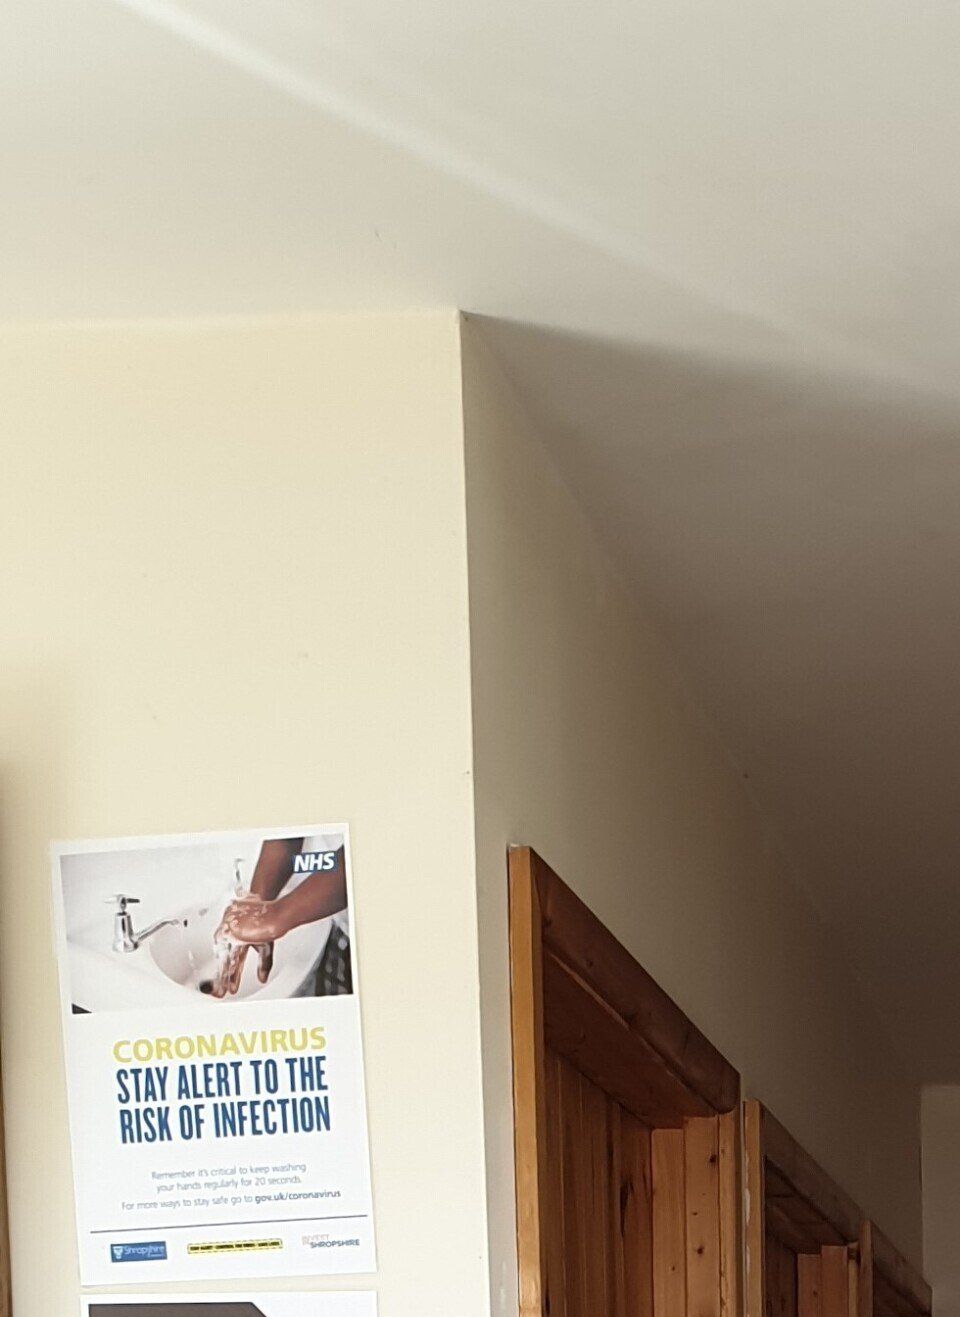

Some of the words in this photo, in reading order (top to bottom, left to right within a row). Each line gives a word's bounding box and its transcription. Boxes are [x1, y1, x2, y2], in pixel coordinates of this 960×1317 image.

[294, 853, 334, 872] NHS
[112, 1027, 327, 1063] CORONAVIRUS
[116, 1065, 168, 1104] STAY
[177, 1062, 243, 1101] ALERT
[250, 1059, 279, 1096] TO
[287, 1055, 329, 1094] THE
[119, 1107, 172, 1144] RISK
[180, 1104, 205, 1141] OF
[213, 1095, 332, 1139] INFECTION
[151, 1170, 195, 1180] Remember
[198, 1168, 208, 1177] it's
[210, 1166, 237, 1176] critical
[239, 1166, 248, 1175] to
[250, 1165, 269, 1175] keep
[272, 1163, 307, 1173] washing
[156, 1184, 175, 1194] your
[176, 1181, 202, 1191] hands
[204, 1178, 238, 1189] regularly
[241, 1177, 252, 1187] for
[254, 1177, 266, 1186] 20
[121, 1201, 135, 1211] For
[137, 1202, 158, 1210] more
[160, 1200, 181, 1209] ways
[182, 1198, 192, 1207] to
[193, 1197, 210, 1207] stay
[212, 1195, 229, 1205] safe
[230, 1196, 242, 1206] go
[244, 1194, 253, 1203] to
[254, 1188, 341, 1205] gov.uk/coronavirus
[310, 1238, 361, 1249] SHROPSHIRE
